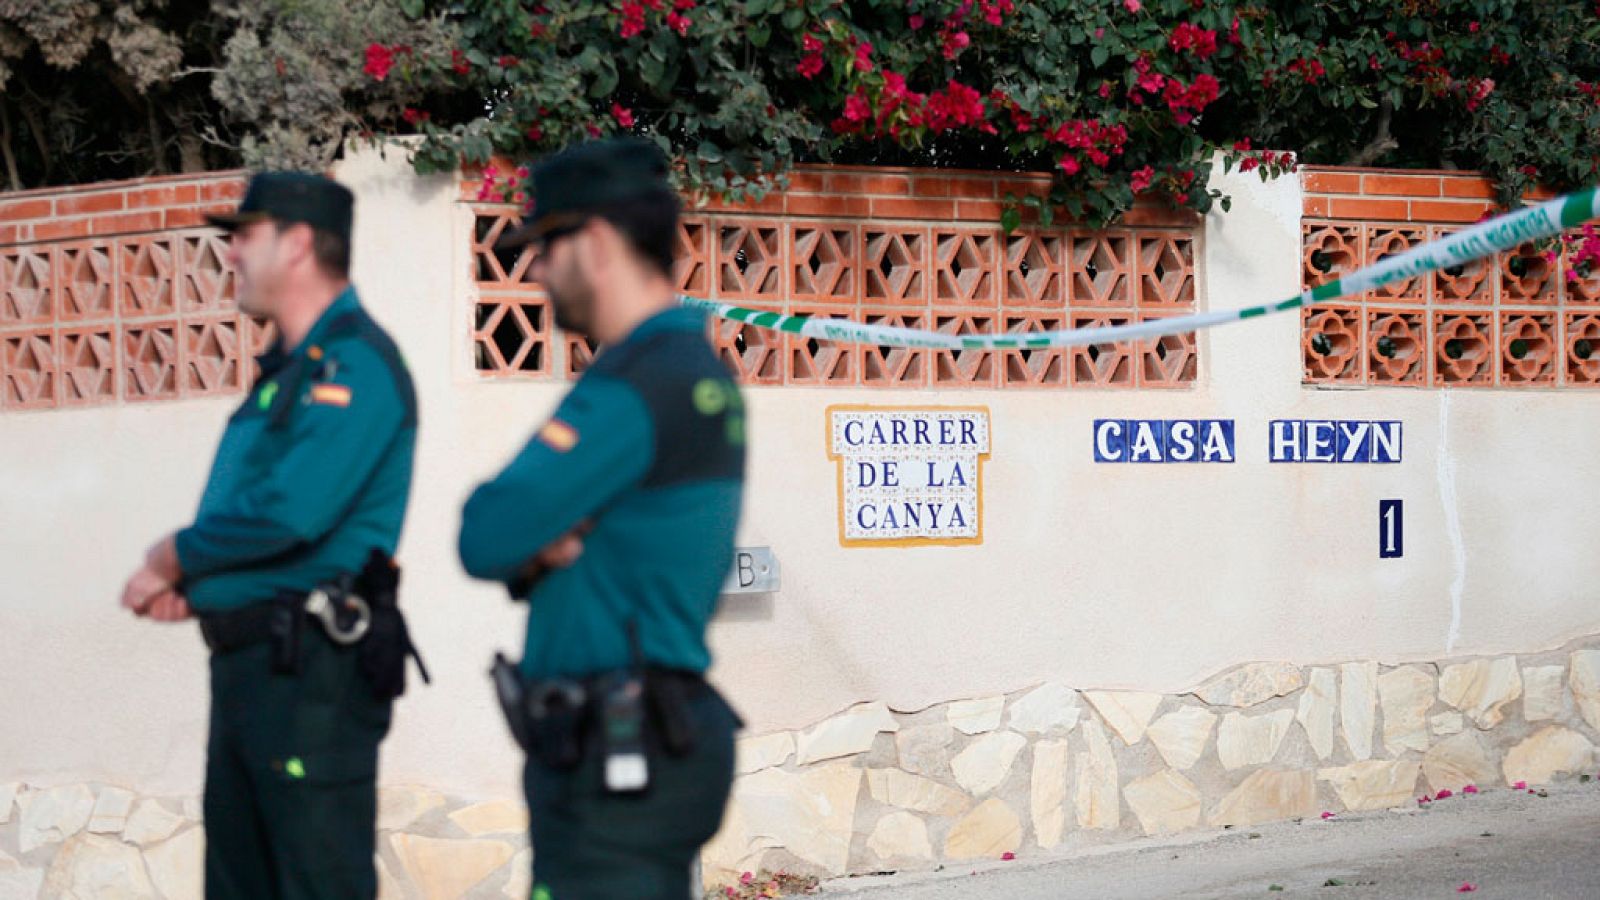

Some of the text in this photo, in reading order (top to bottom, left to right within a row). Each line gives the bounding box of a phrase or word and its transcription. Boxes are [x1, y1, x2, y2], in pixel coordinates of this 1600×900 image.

[844, 419, 978, 446] CARRER
[1096, 421, 1401, 461] CASA HEYN
[857, 461, 967, 487] DE LA
[857, 502, 967, 529] CANYA
[1383, 504, 1397, 553] 1
[737, 552, 756, 588] B
